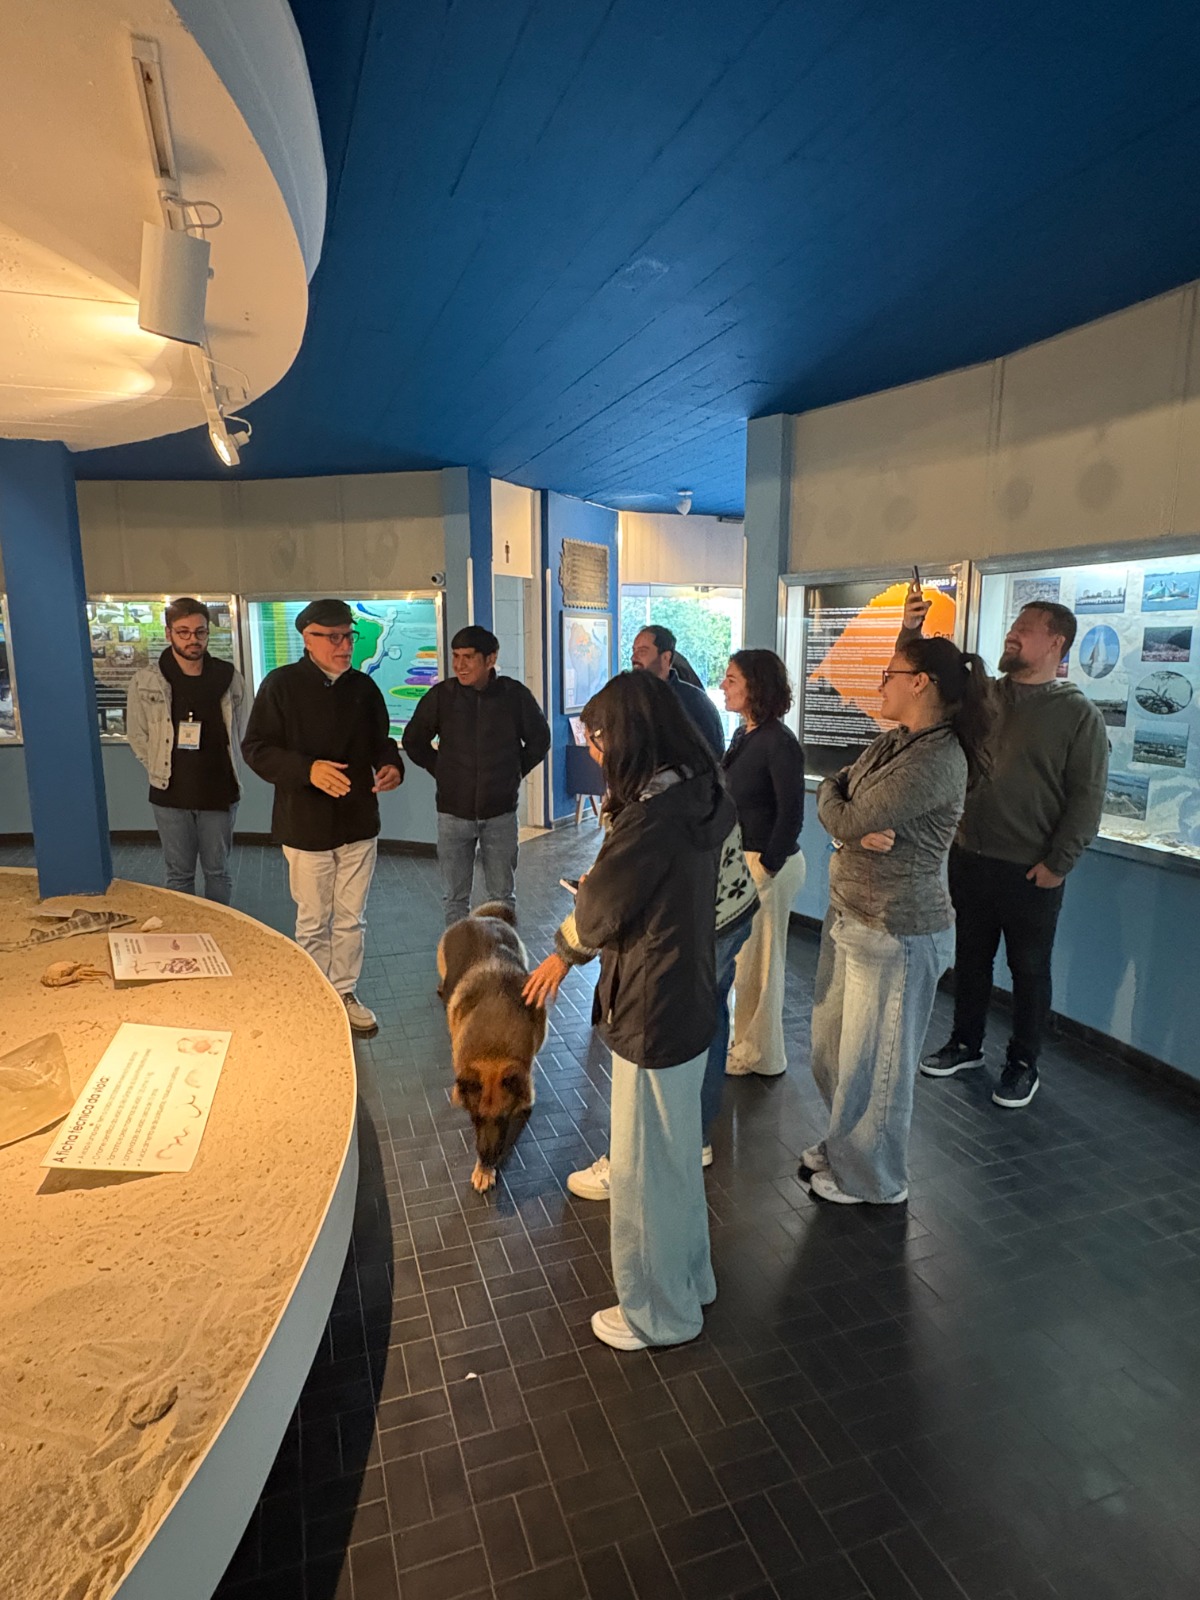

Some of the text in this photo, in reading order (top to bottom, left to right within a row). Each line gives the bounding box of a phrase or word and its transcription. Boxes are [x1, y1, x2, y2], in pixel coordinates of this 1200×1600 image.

[923, 578, 950, 587] Lagoas
[56, 1134, 79, 1156] ficha
[68, 1104, 95, 1134] técnica
[87, 1093, 101, 1105] da
